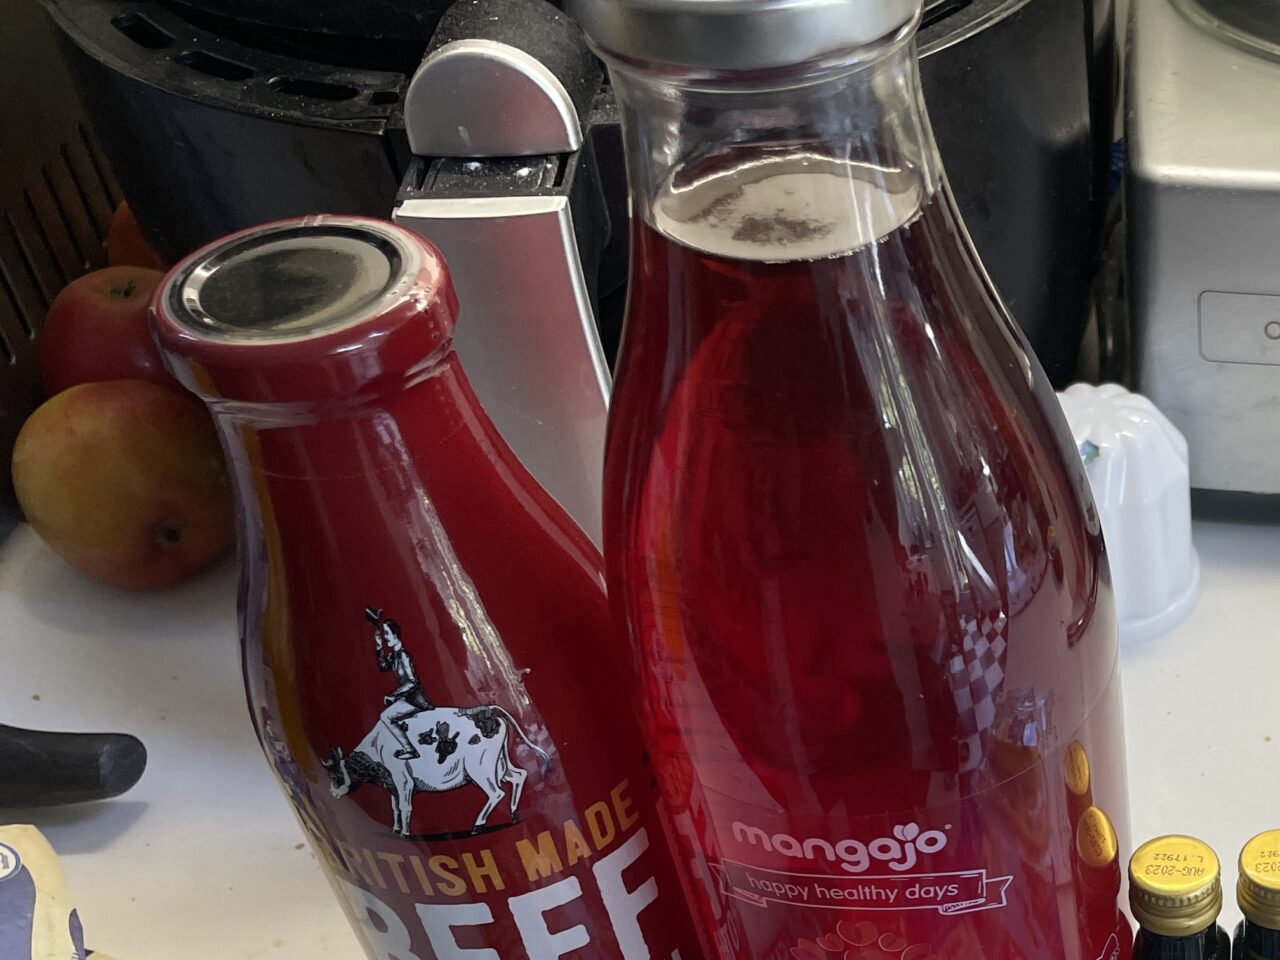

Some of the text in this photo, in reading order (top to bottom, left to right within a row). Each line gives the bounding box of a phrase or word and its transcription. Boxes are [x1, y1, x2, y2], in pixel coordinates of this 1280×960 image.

[516, 779, 639, 882] MADE
[732, 821, 948, 873] mangajo
[747, 872, 959, 903] happy healthy days
